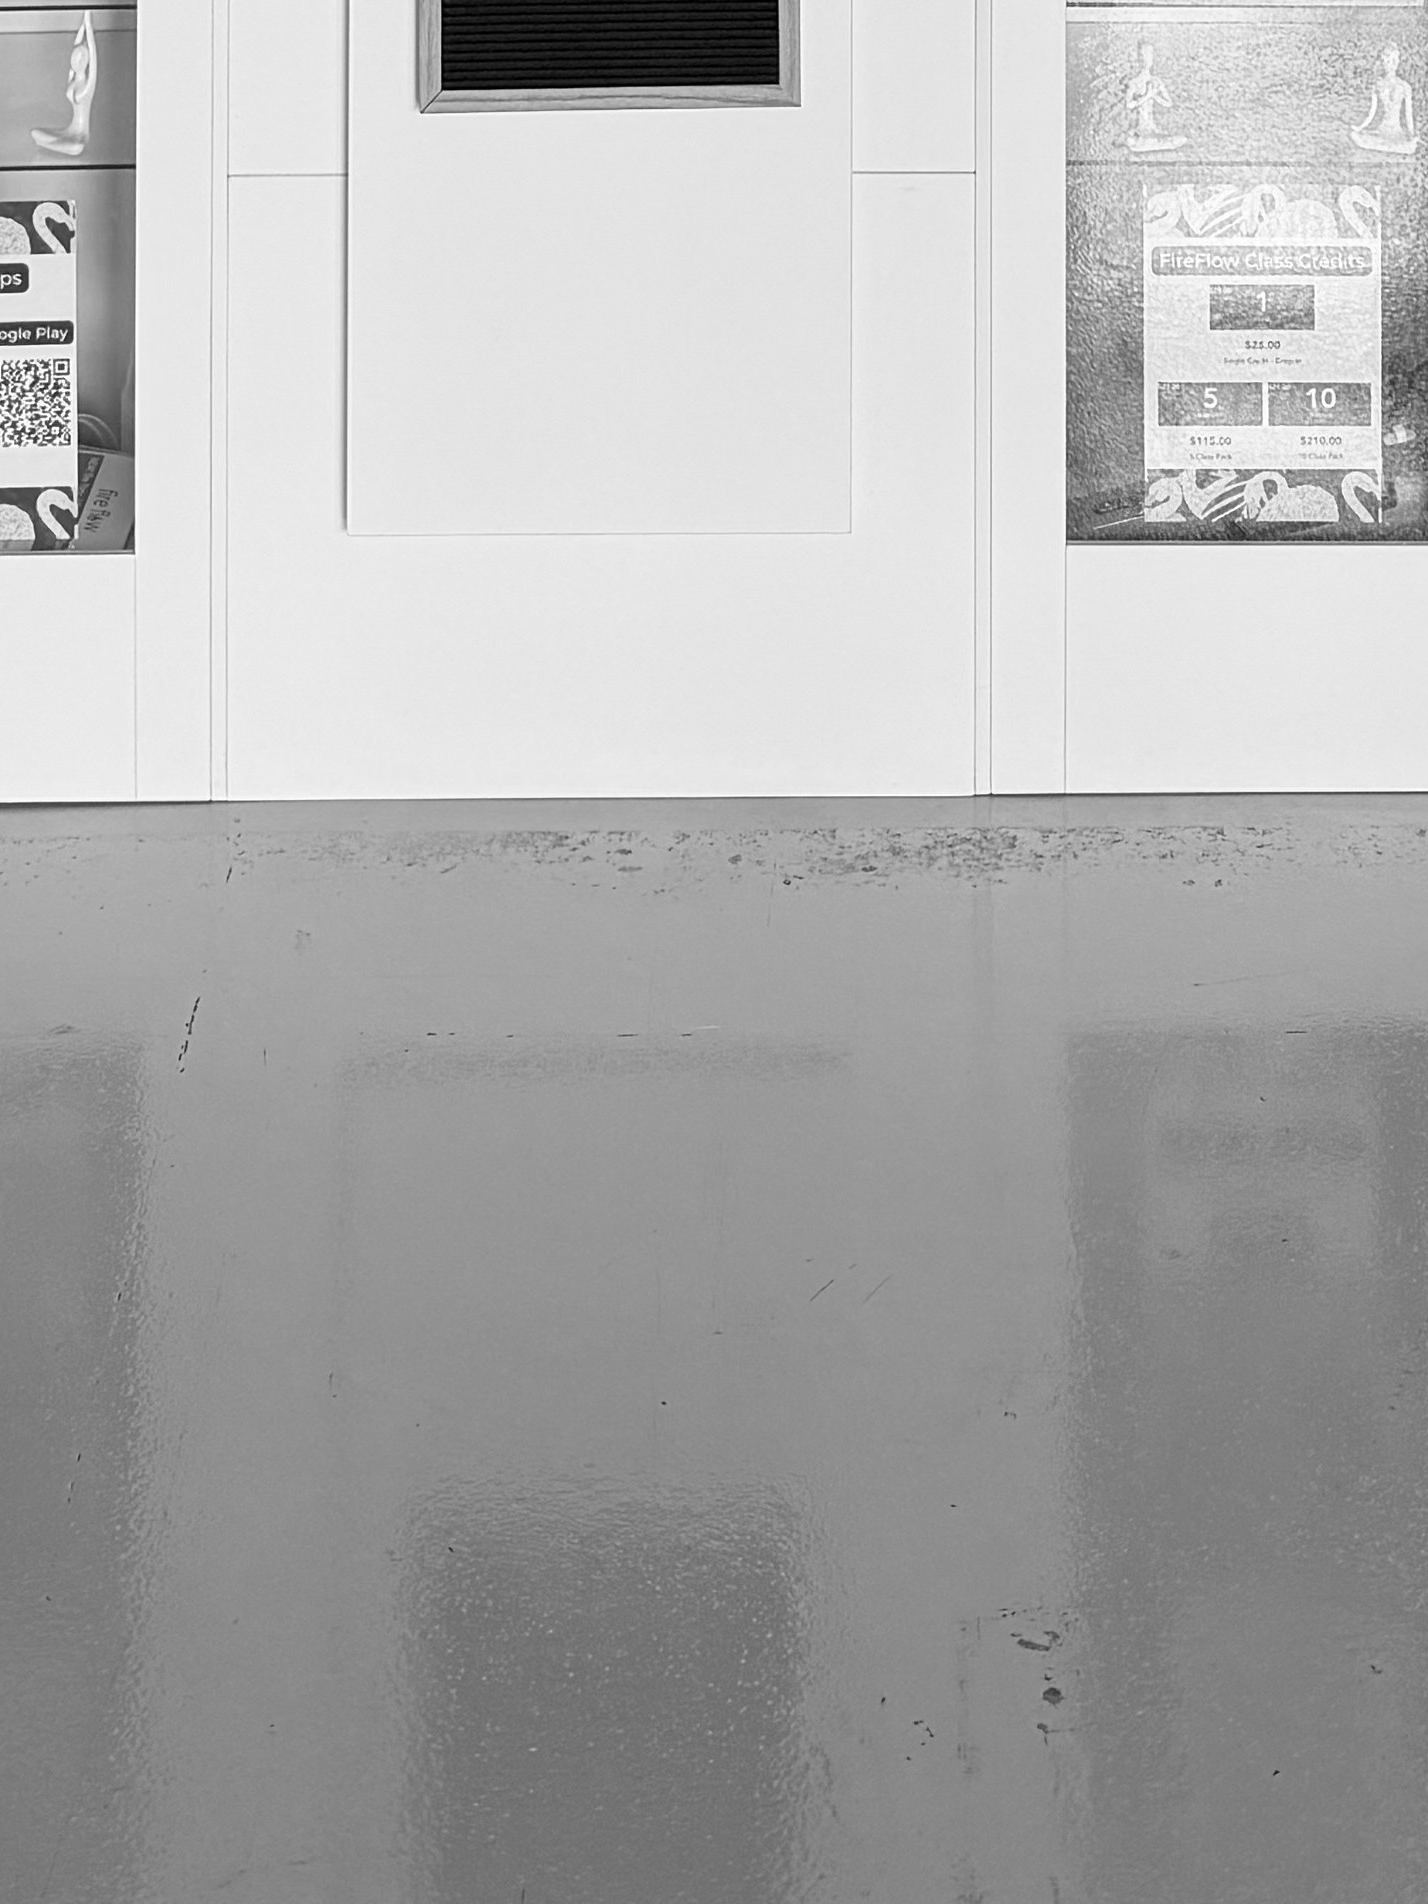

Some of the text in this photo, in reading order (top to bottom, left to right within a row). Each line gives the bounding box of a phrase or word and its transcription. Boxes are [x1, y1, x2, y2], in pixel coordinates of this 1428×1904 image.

[1159, 253, 1365, 270] FireFlow Class Credits
[1257, 291, 1267, 312] 1
[36, 326, 68, 341] Play
[1203, 387, 1218, 409] 5
[1305, 387, 1338, 409] 10
